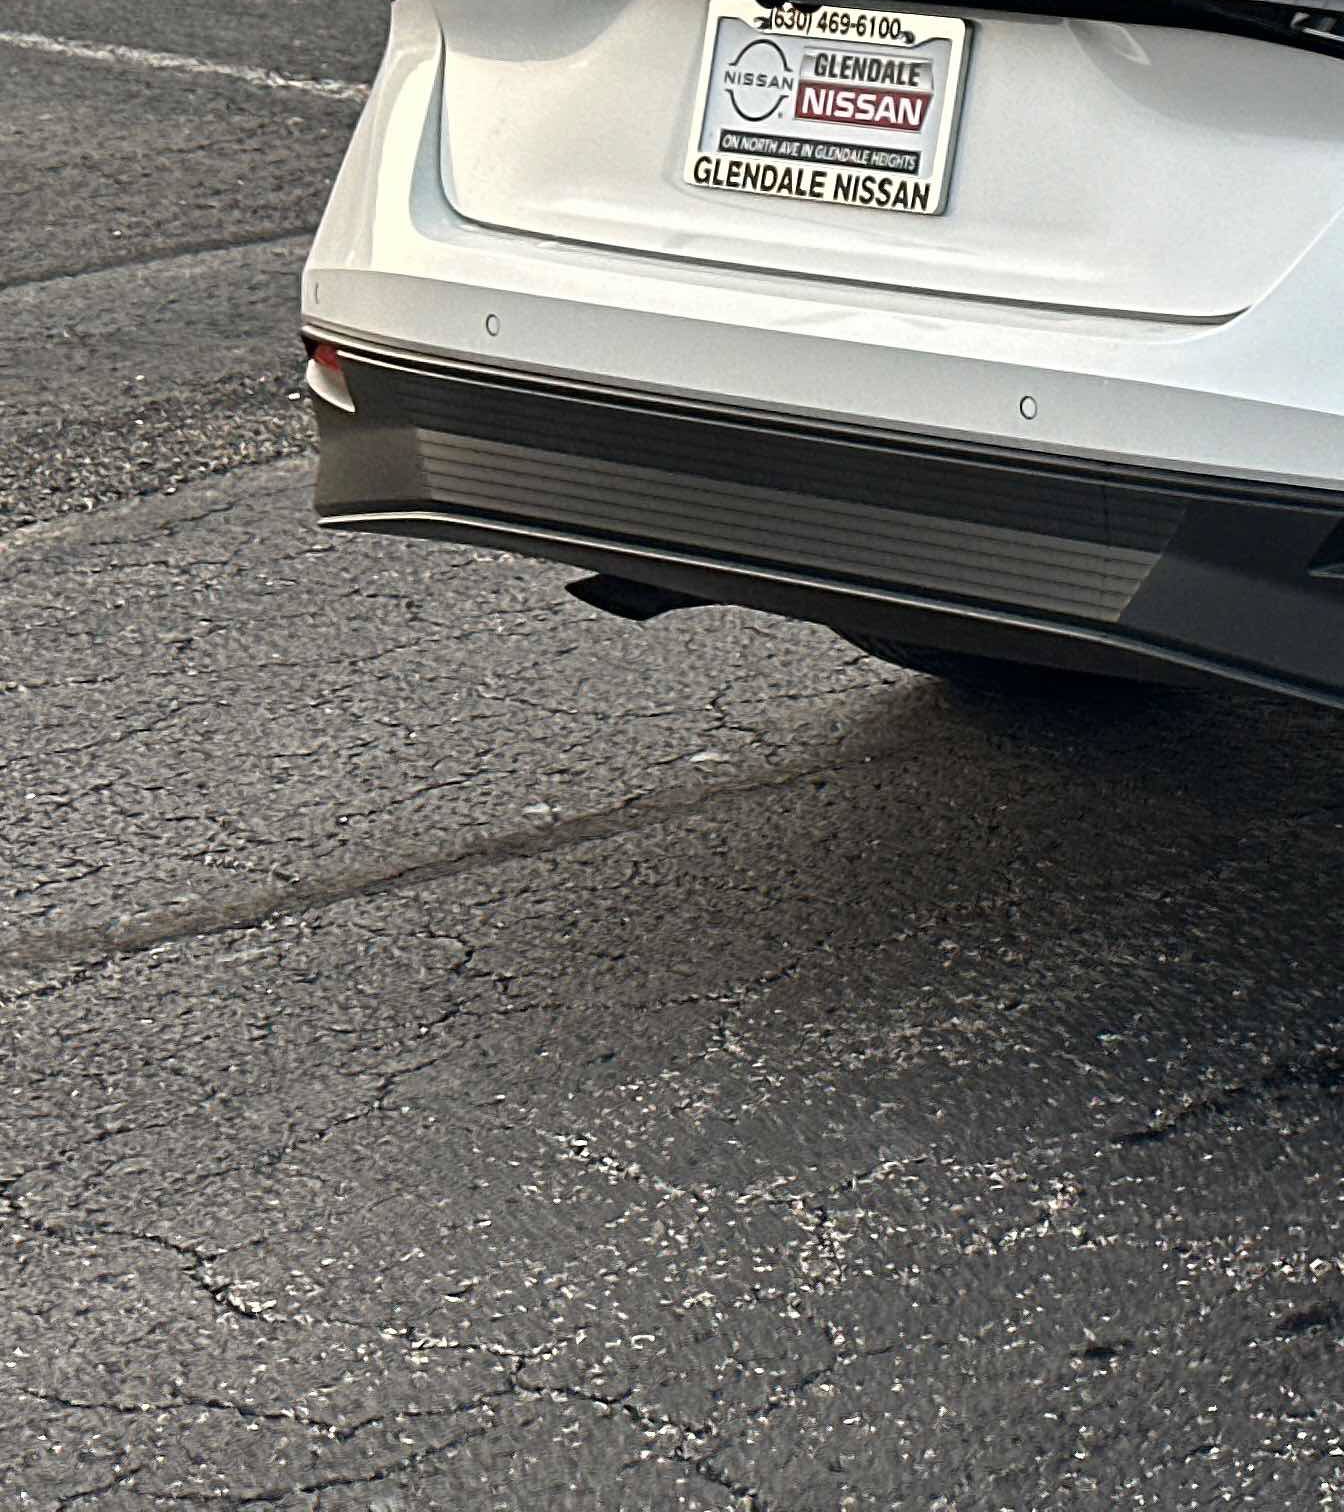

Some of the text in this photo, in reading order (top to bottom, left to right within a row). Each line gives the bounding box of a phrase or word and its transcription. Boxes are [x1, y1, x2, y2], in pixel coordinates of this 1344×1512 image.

[769, 6, 902, 39] (630) 469-6100
[724, 69, 794, 90] NISSAN
[814, 52, 922, 87] GLENDALE
[801, 88, 923, 126] NISSAN
[722, 134, 918, 171] ON NORTH AVE IN GLENDALE HEIGHTS
[693, 156, 932, 210] GLENDALE NISSAN
